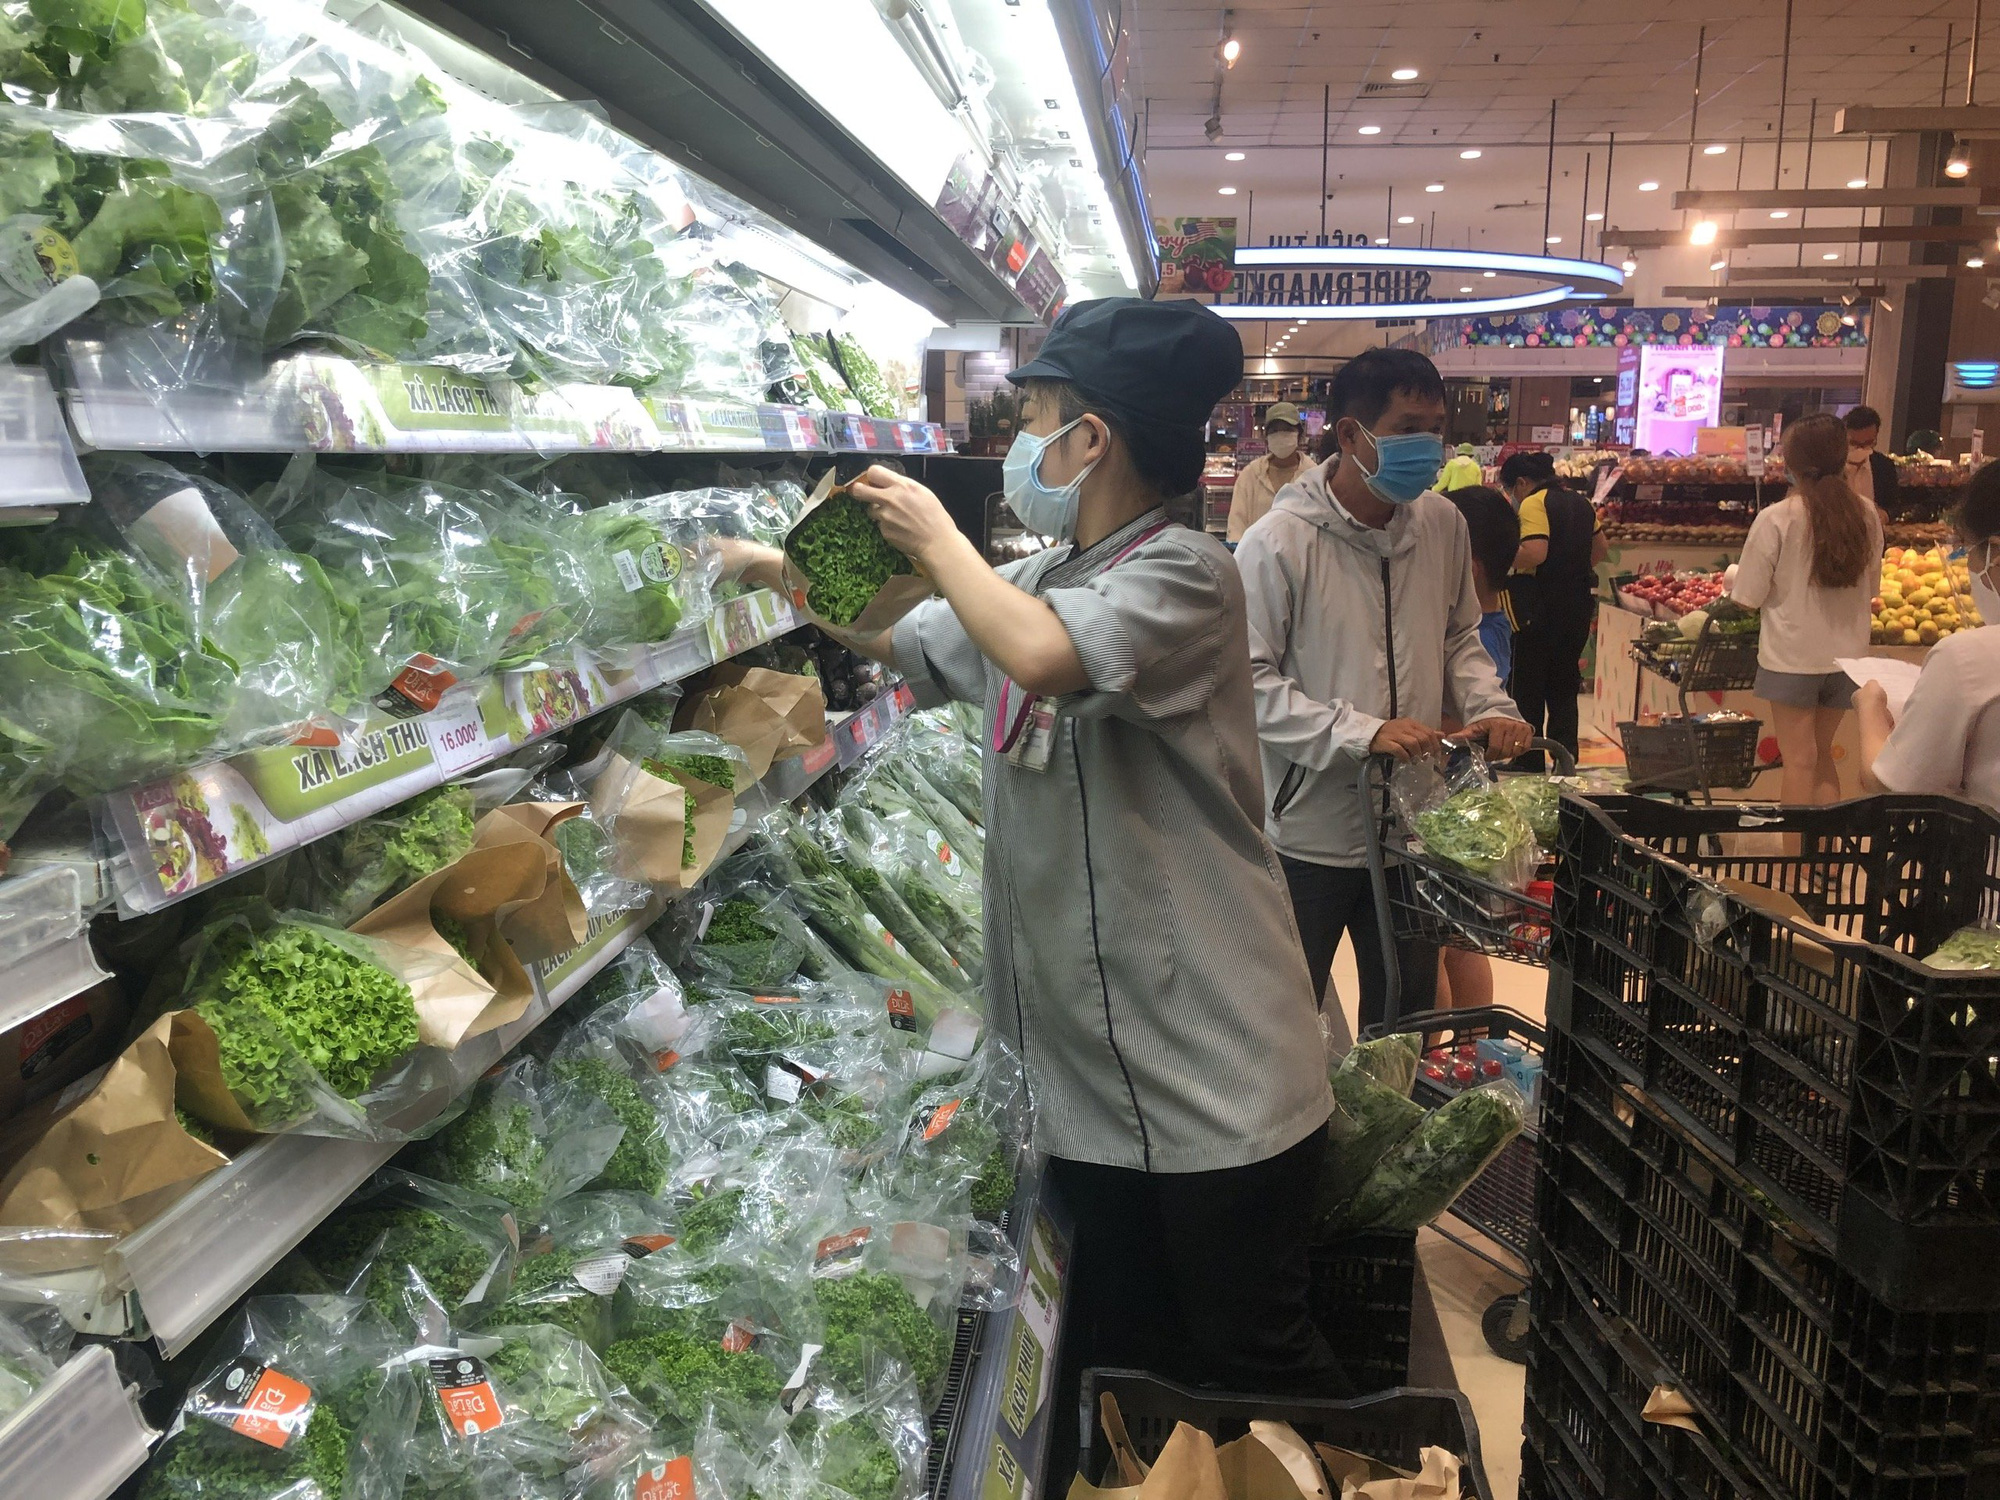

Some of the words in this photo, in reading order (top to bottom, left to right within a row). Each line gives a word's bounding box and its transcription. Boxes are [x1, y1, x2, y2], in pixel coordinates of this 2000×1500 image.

[403, 373, 434, 413] XÀ
[430, 376, 478, 416] LÁCH
[1009, 1378, 1030, 1440] LÁCH
